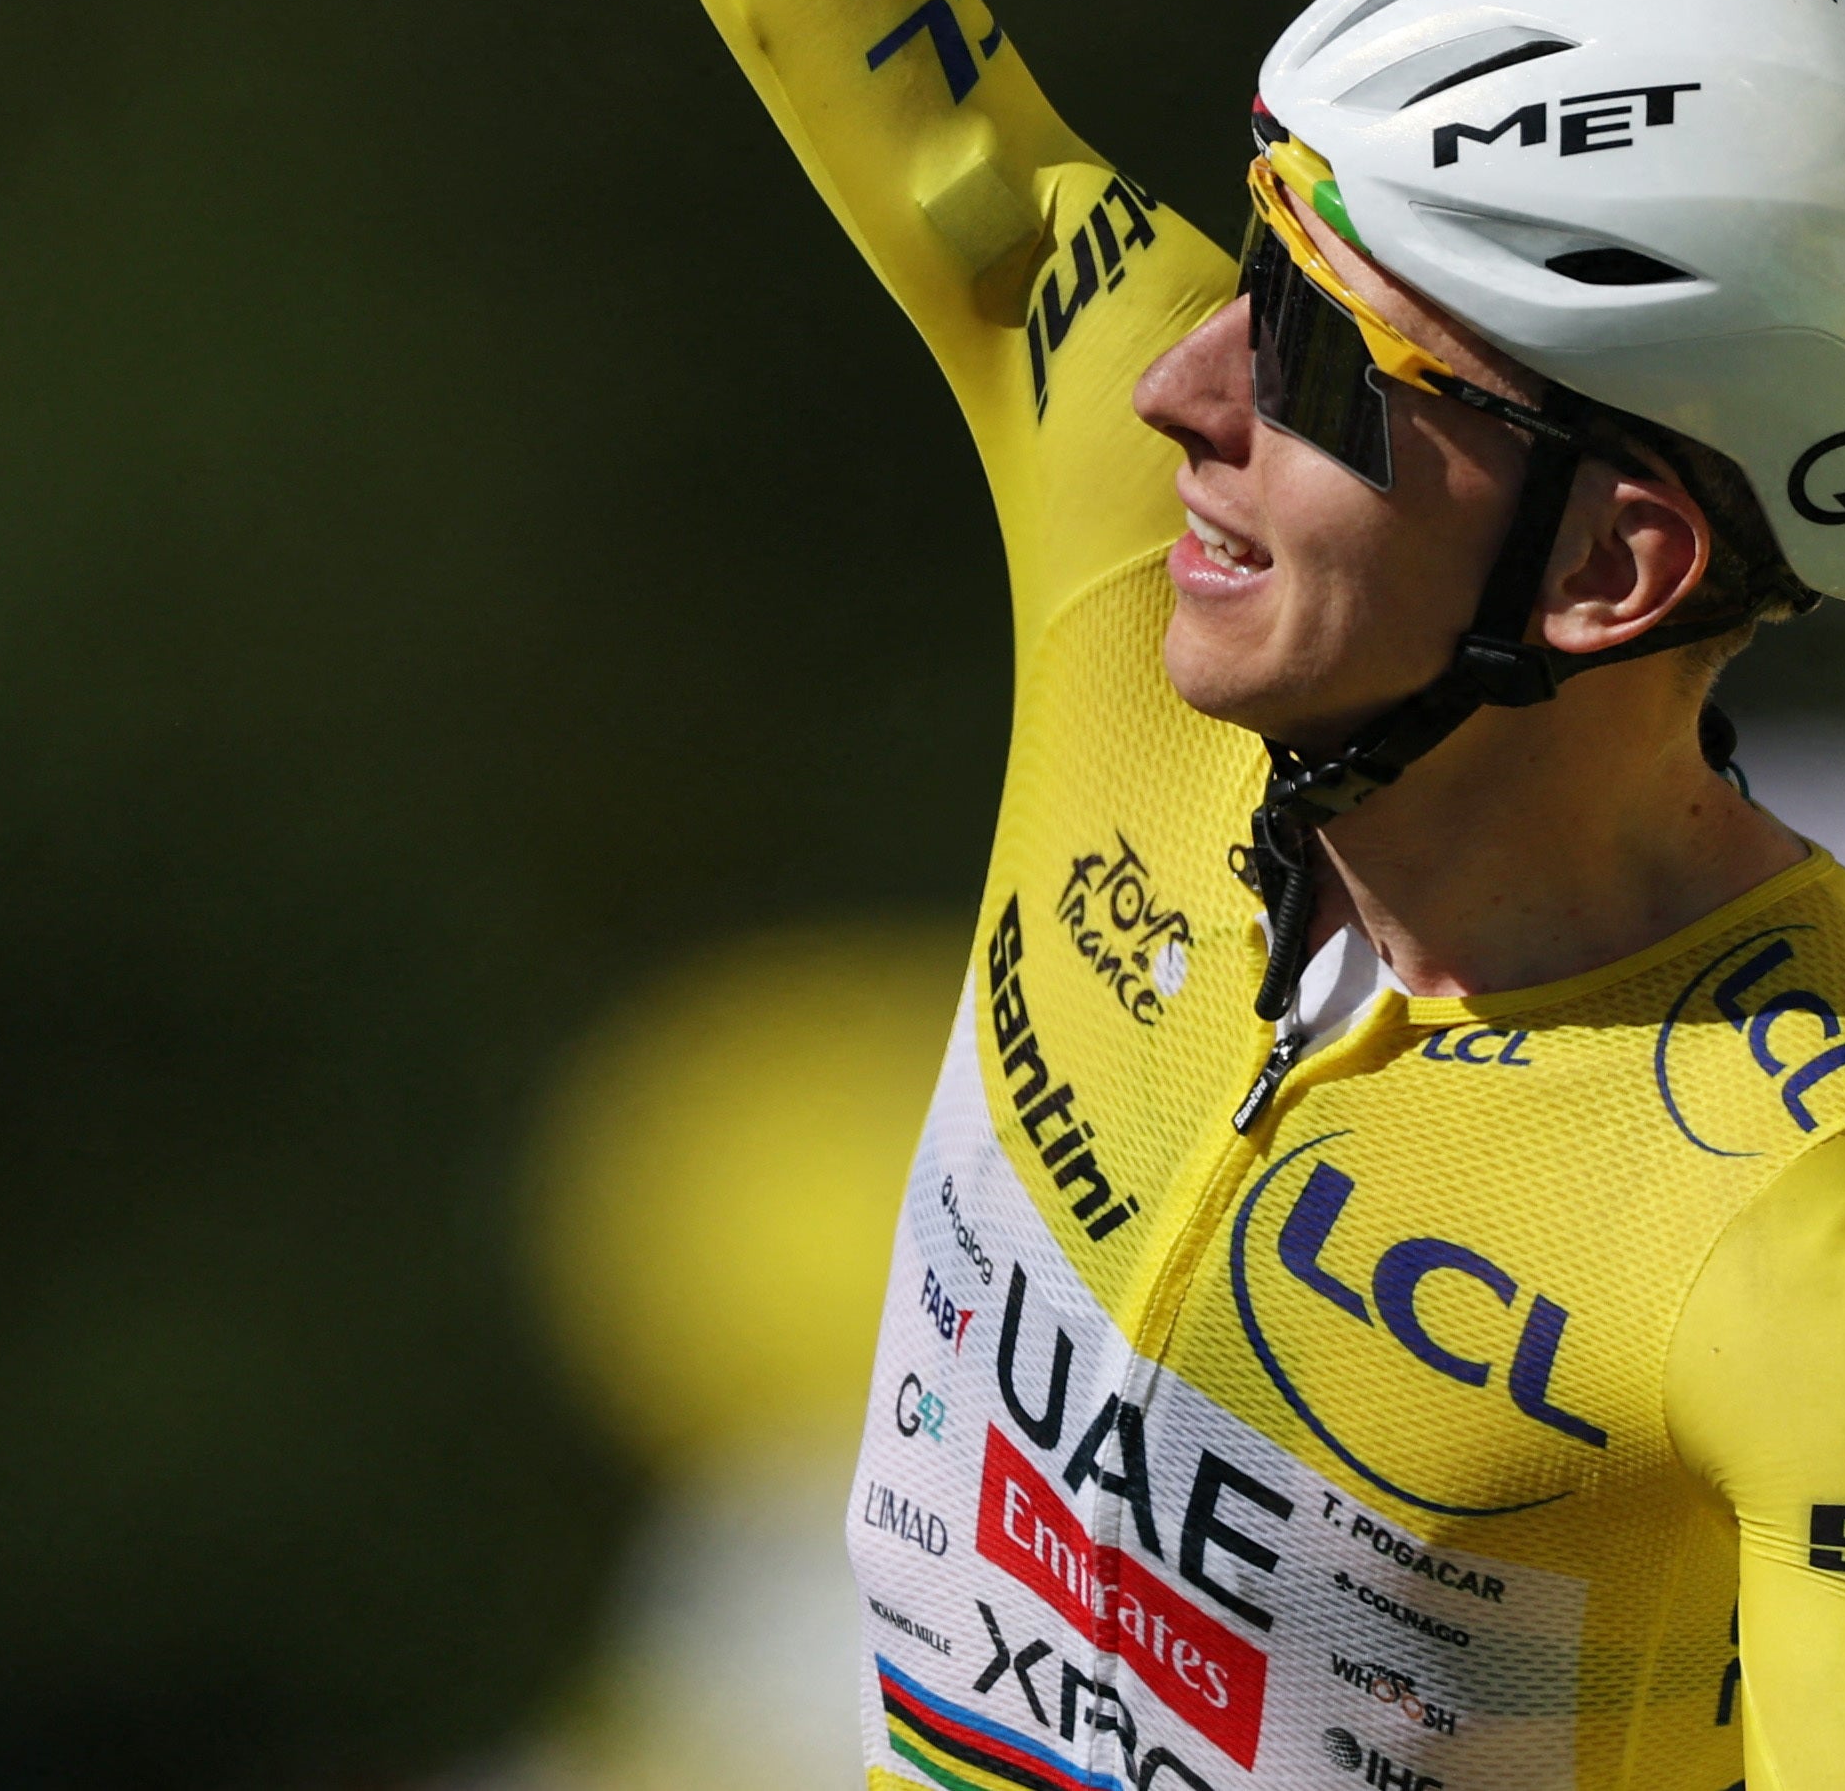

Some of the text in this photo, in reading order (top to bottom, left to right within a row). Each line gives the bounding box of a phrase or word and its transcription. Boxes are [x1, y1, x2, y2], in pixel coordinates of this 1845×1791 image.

[1434, 82, 1701, 169] MET
[1025, 171, 1157, 427] tini
[989, 891, 1140, 1243] Santini
[1421, 1026, 1533, 1066] LCL
[1234, 1077, 1268, 1130] Santini
[1277, 1160, 1608, 1449] LCL
[896, 1372, 946, 1443] G42
[996, 1259, 1296, 1634] UAE
[864, 1481, 948, 1557] L'IMAD
[1320, 1490, 1506, 1604] T. POGACAR
[1003, 1474, 1231, 1710] Emirates
[1358, 1584, 1471, 1649] COLNAGO
[914, 1623, 953, 1657] MILLE
[1331, 1652, 1456, 1737] WHOOSH
